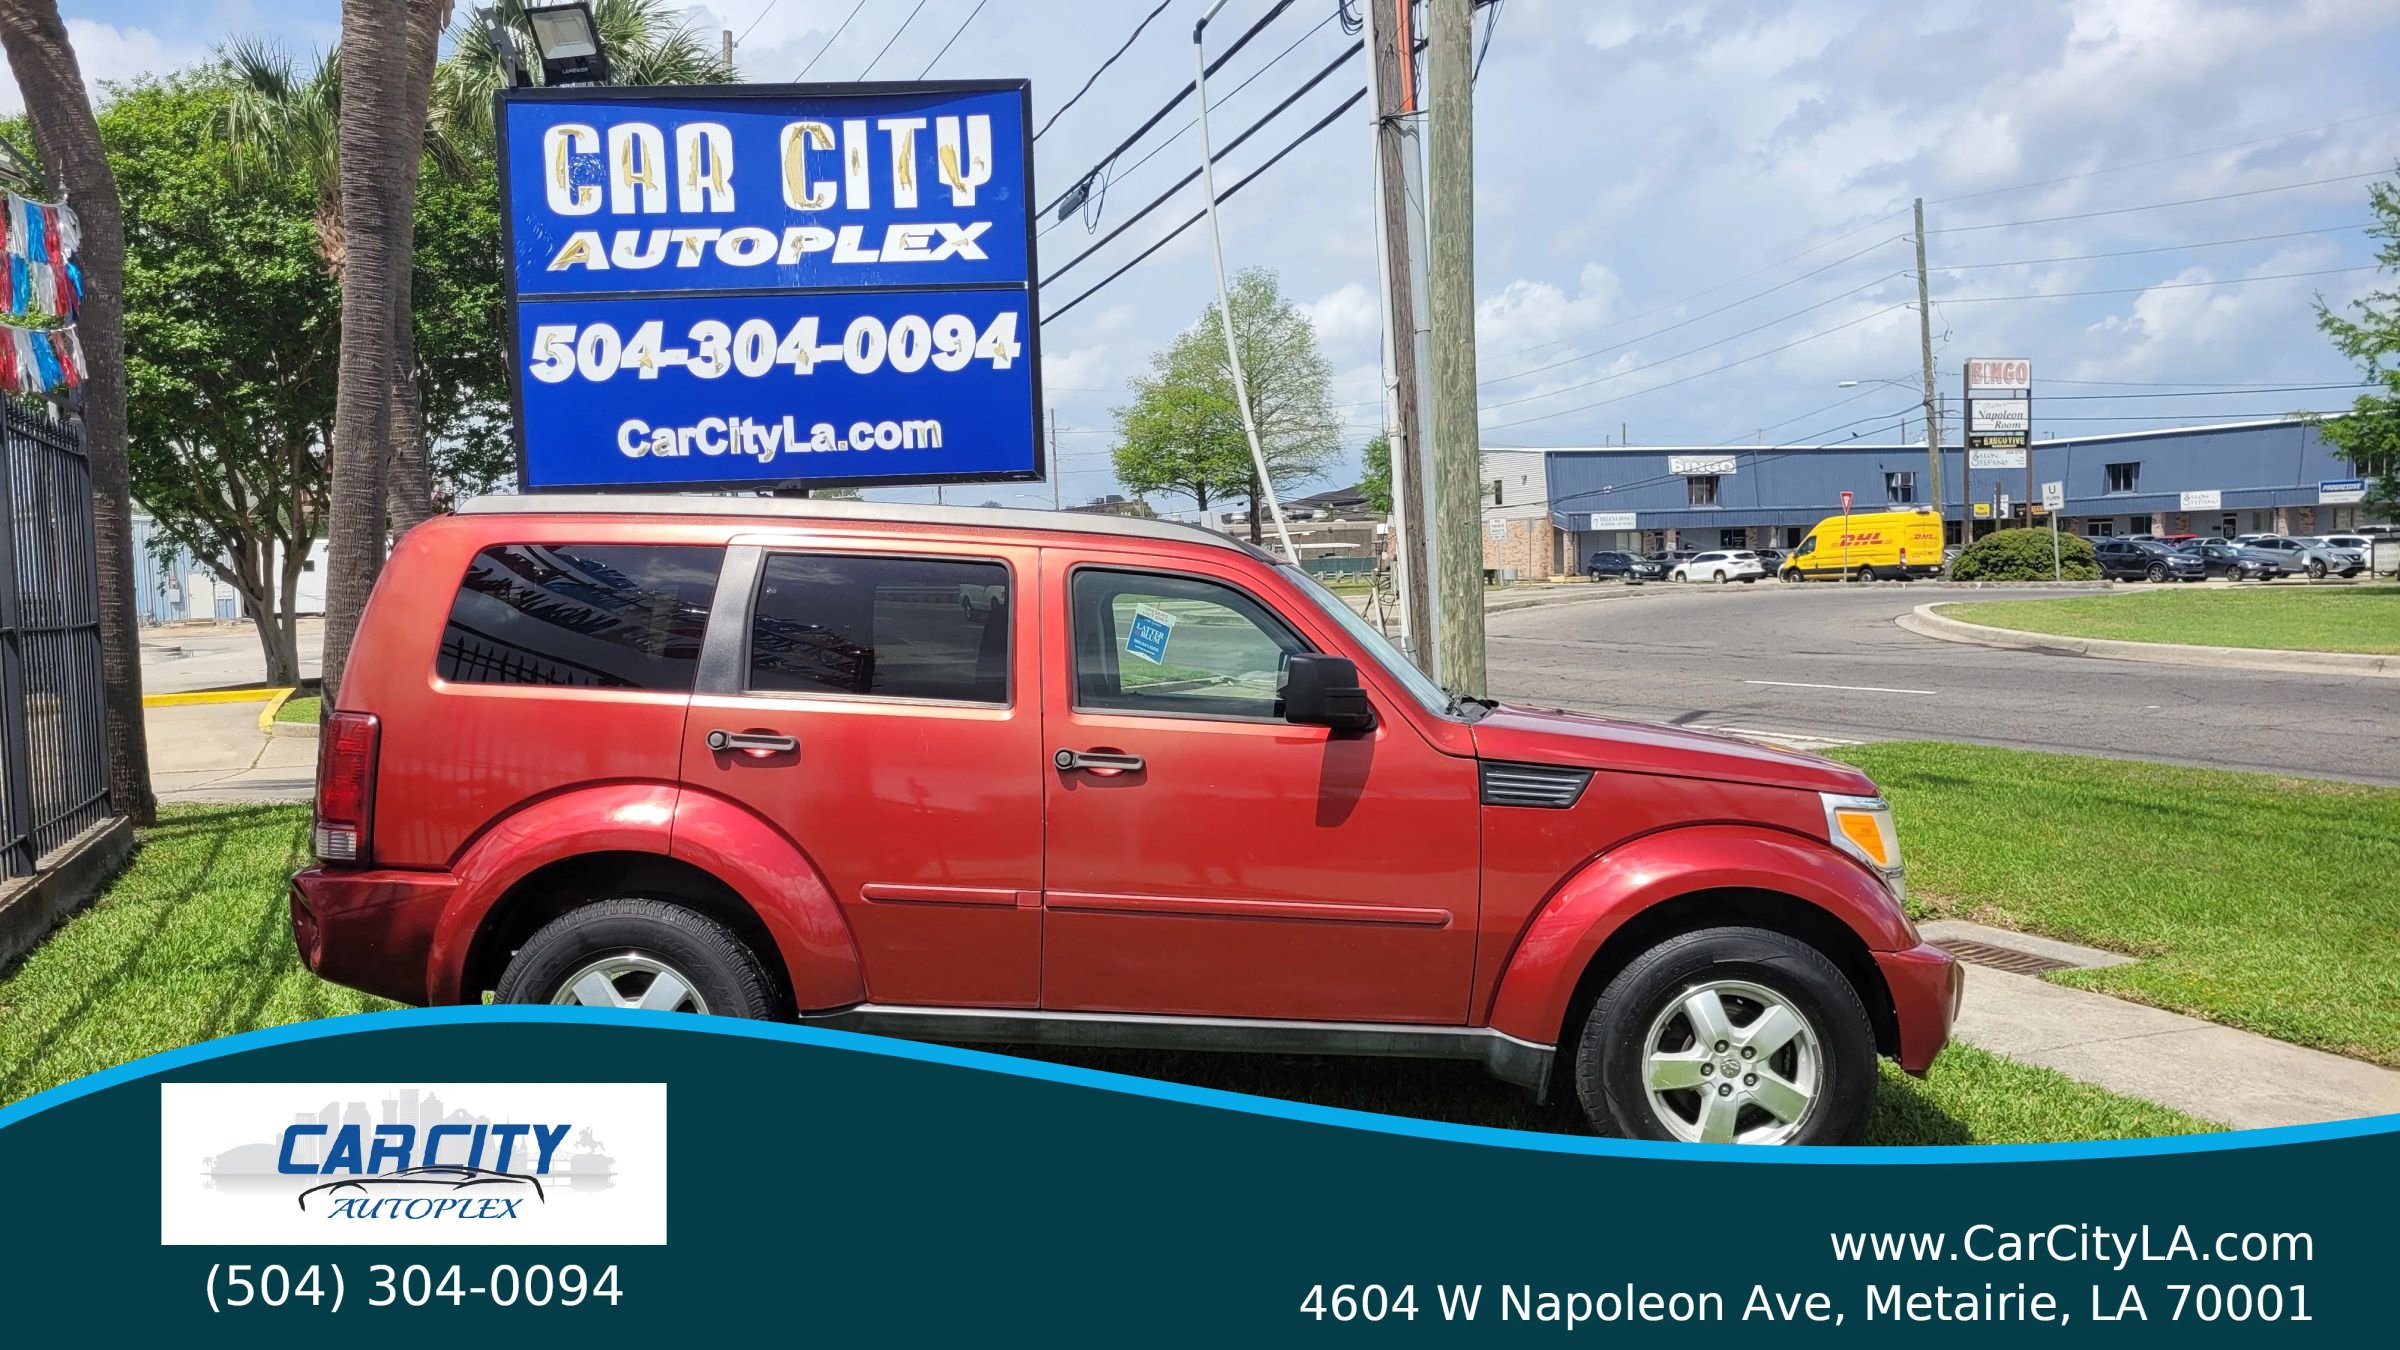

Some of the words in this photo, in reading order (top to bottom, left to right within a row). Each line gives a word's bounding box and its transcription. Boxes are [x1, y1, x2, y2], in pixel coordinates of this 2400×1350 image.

[544, 122, 736, 216] CAR
[779, 115, 993, 212] CITY
[547, 222, 993, 271] AUTOPLEX
[528, 312, 1022, 384] 504-304-0094
[1972, 362, 2028, 384] BINGO
[1978, 410, 2024, 421] Napoleon
[1995, 421, 2021, 429] Room
[617, 415, 943, 463] CarCityLa.com
[1984, 437, 2025, 445] EXECUTIVE
[1671, 458, 1734, 473] BINGO
[2049, 485, 2056, 494] U
[1839, 533, 1883, 547] DHL
[1136, 622, 1165, 640] LATTER
[1140, 631, 1161, 645] BLUM
